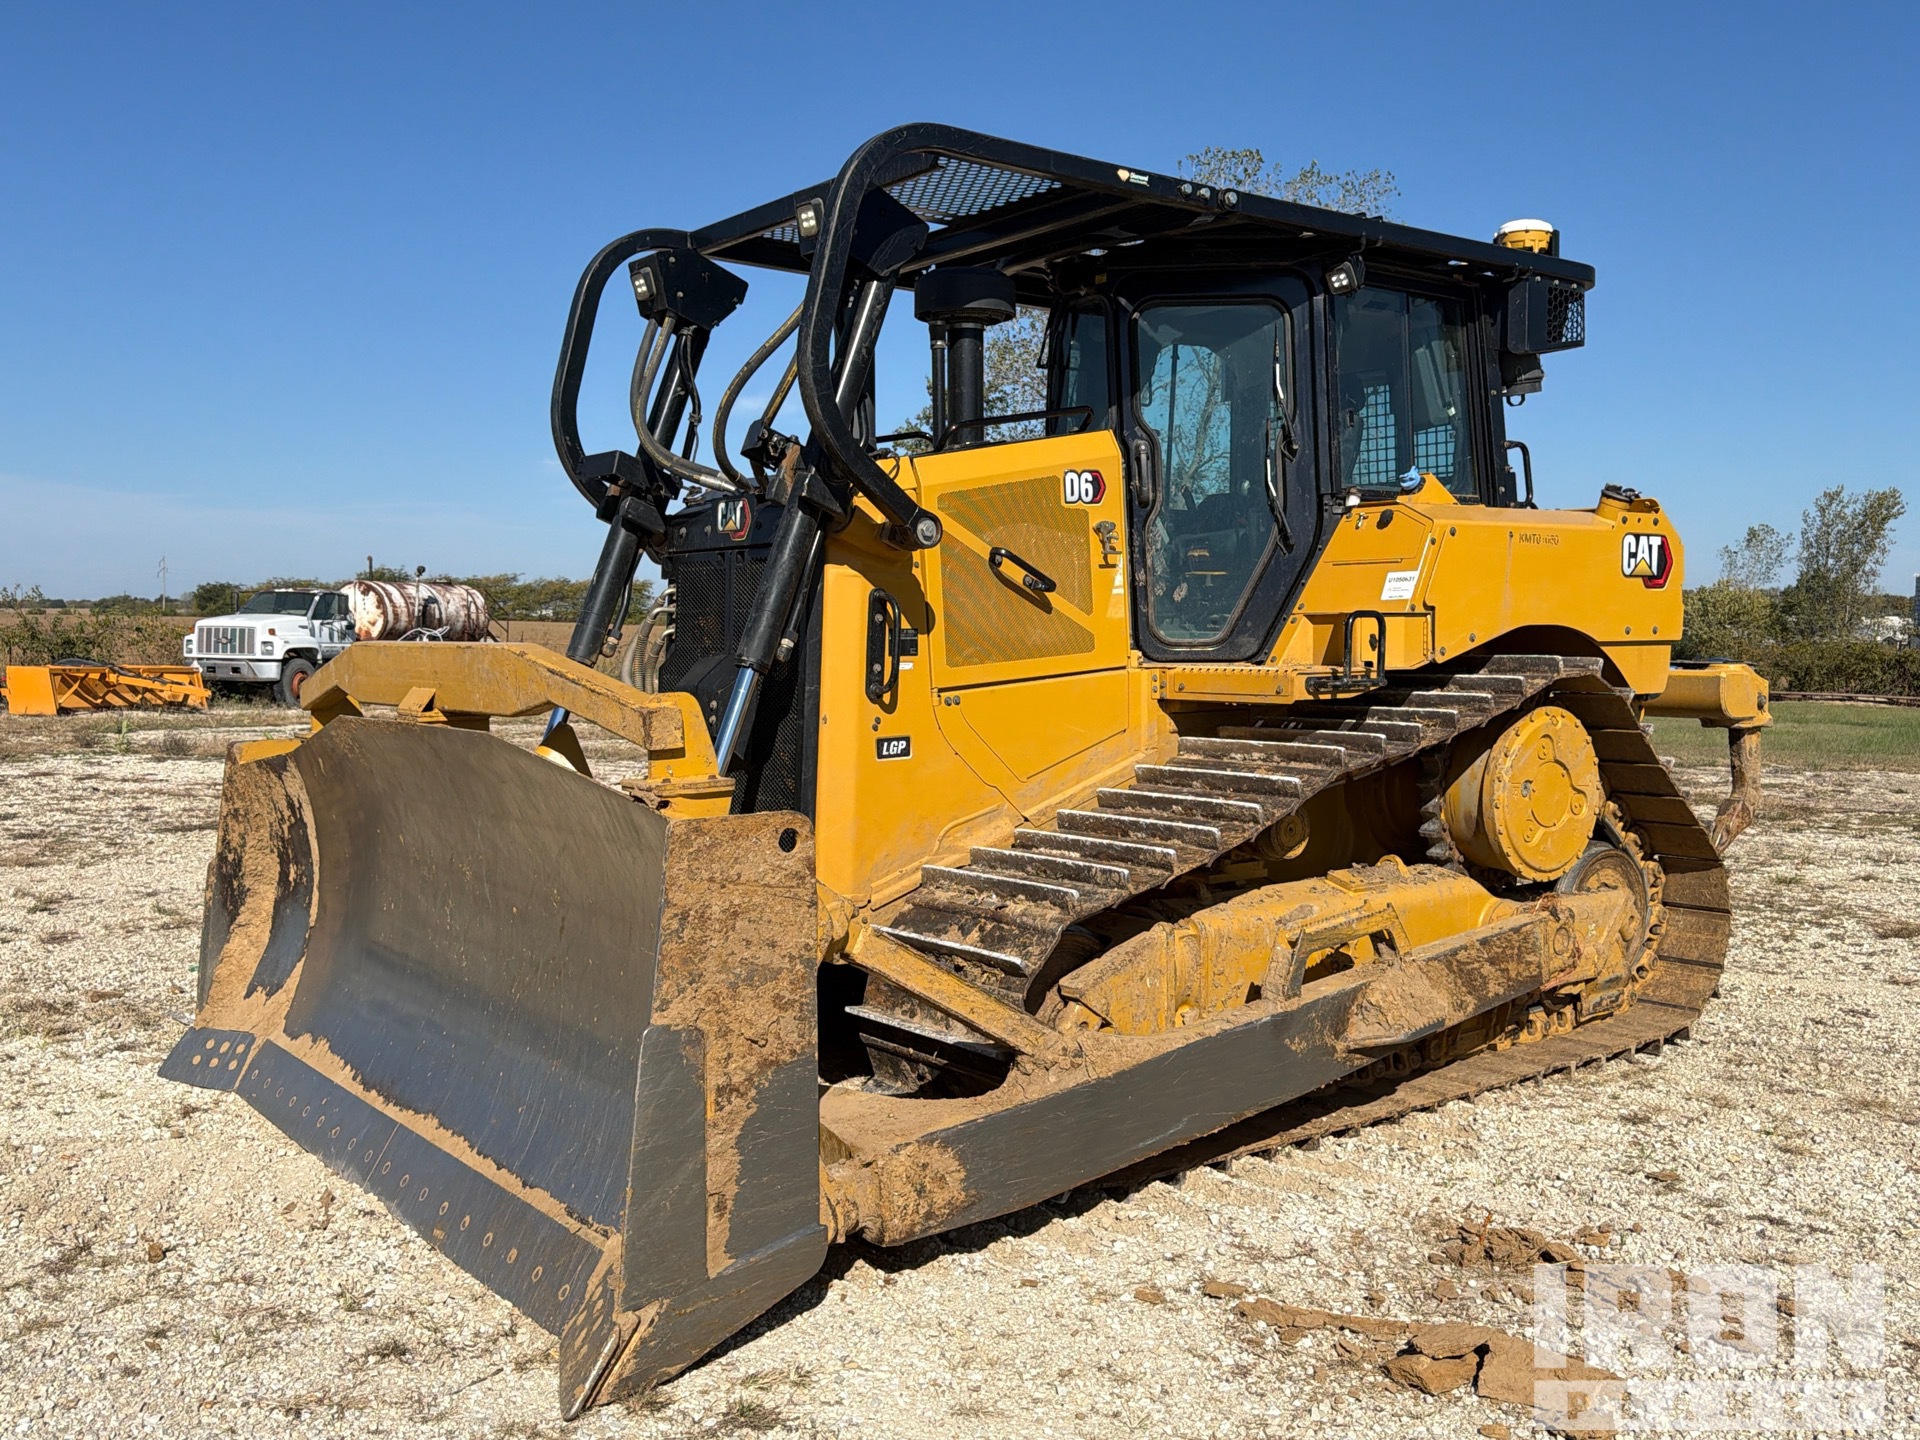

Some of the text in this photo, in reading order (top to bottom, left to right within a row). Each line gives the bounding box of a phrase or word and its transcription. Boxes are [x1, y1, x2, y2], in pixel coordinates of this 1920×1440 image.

[1064, 471, 1094, 503] D6
[717, 499, 744, 532] CAT
[1622, 534, 1662, 576] CAT
[882, 740, 907, 755] LGP
